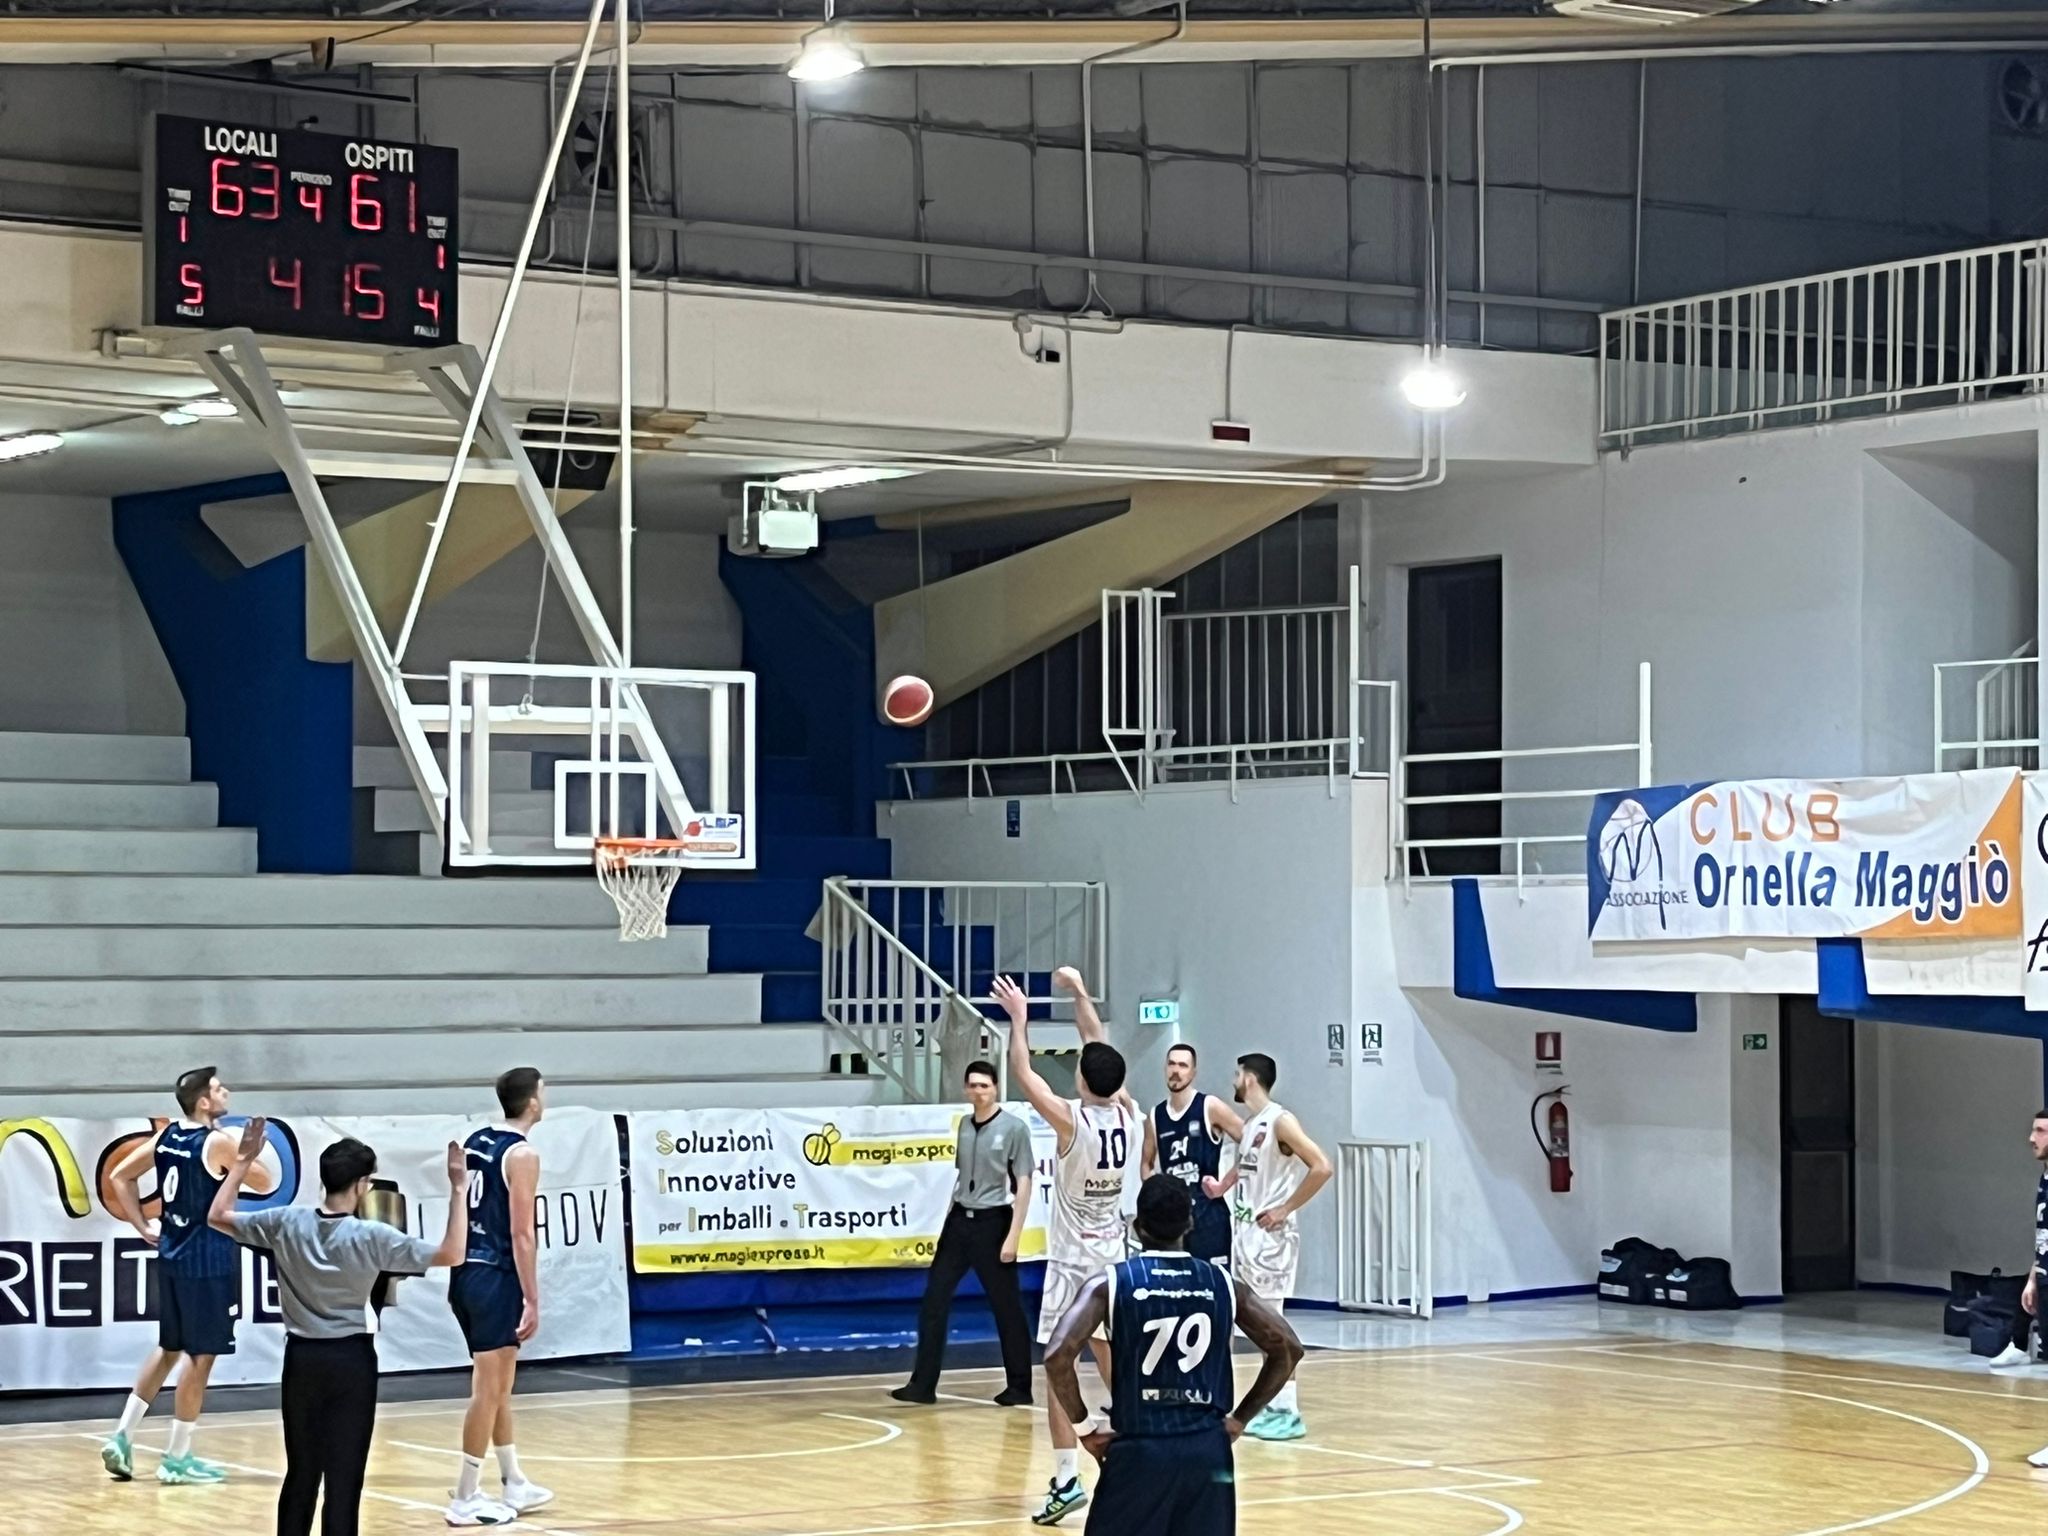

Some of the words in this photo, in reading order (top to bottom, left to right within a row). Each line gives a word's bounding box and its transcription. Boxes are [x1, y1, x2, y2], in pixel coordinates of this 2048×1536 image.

[204, 126, 277, 158] LOCALI
[345, 142, 414, 173] OSPITI
[211, 158, 280, 221] 63
[300, 186, 322, 223] 4
[351, 174, 416, 233] 61
[180, 216, 189, 243] 1
[436, 243, 446, 270] 1
[180, 263, 204, 305] 5
[269, 257, 302, 311] 4
[417, 287, 440, 325] 4
[1690, 790, 1841, 846] CLUB
[1694, 850, 1837, 909] Ornella
[1855, 840, 2010, 922] Maggiò
[655, 1129, 774, 1156] Soluzioni
[1096, 1128, 1127, 1170] 10
[658, 1166, 797, 1195] Innovative
[658, 1220, 682, 1235] per
[688, 1204, 773, 1234] Imballi
[793, 1203, 908, 1239] Trasporti
[1141, 1312, 1212, 1376] 79
